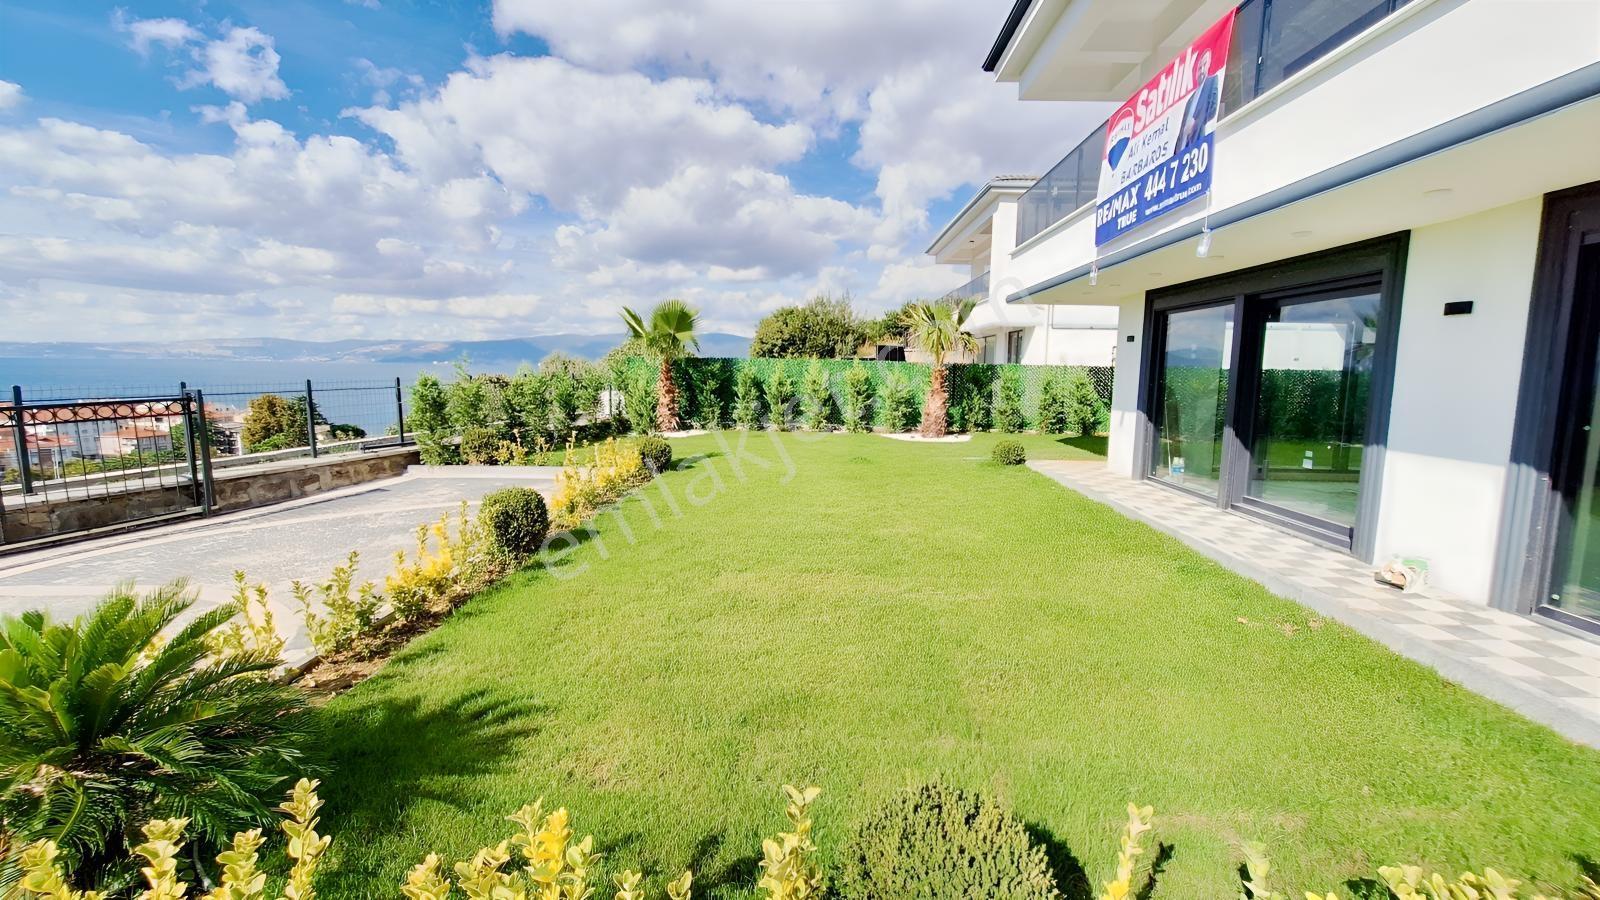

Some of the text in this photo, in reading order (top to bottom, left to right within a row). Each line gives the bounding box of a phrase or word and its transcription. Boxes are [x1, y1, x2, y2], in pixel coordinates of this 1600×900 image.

[1134, 48, 1199, 135] Satılık
[1144, 142, 1208, 201] 444 7 230
[1096, 182, 1141, 228] RE/MAX
[1117, 209, 1138, 230] TRUE
